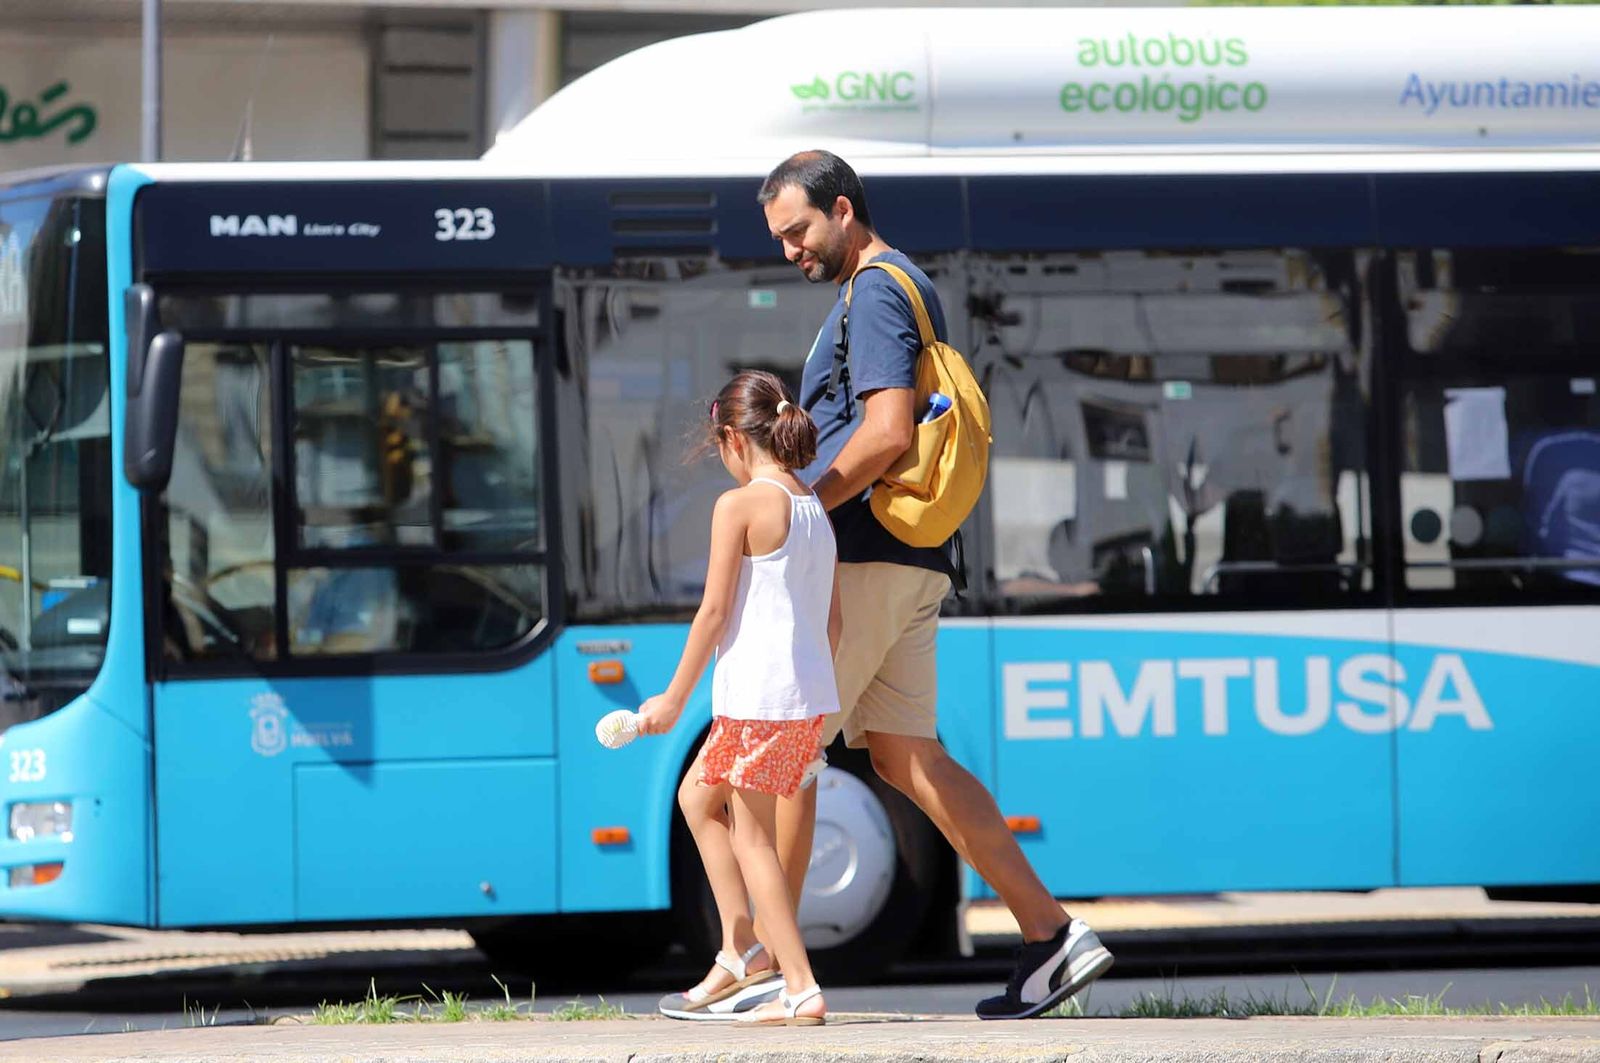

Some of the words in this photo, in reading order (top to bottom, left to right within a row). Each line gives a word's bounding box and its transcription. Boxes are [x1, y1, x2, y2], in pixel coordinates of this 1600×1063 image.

[1077, 32, 1249, 67] autobus
[836, 70, 915, 102] GNC
[1060, 73, 1268, 122] ecológico
[209, 214, 298, 236] MAN
[434, 207, 496, 241] 323
[1003, 653, 1494, 740] EMTUSA
[8, 749, 47, 782] 323
